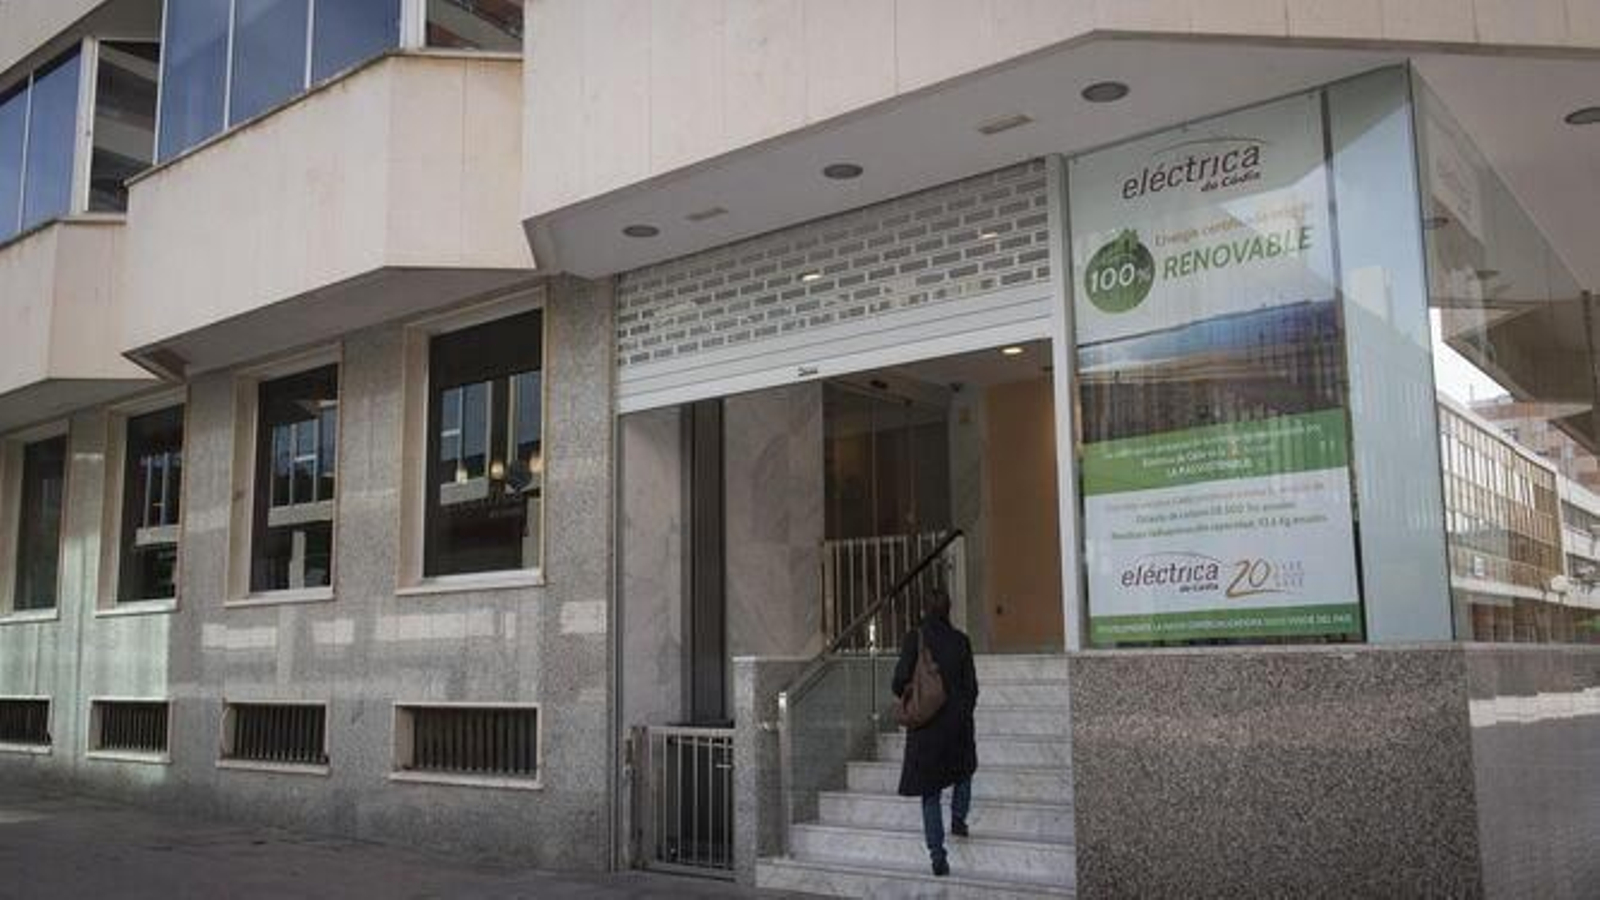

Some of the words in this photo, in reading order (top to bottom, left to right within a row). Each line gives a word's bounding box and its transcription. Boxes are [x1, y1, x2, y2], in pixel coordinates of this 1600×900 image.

[1122, 145, 1260, 199] eléctrica
[1163, 226, 1314, 280] RENOVABLE
[1121, 562, 1219, 587] eléctrica
[1225, 558, 1280, 597] 20
